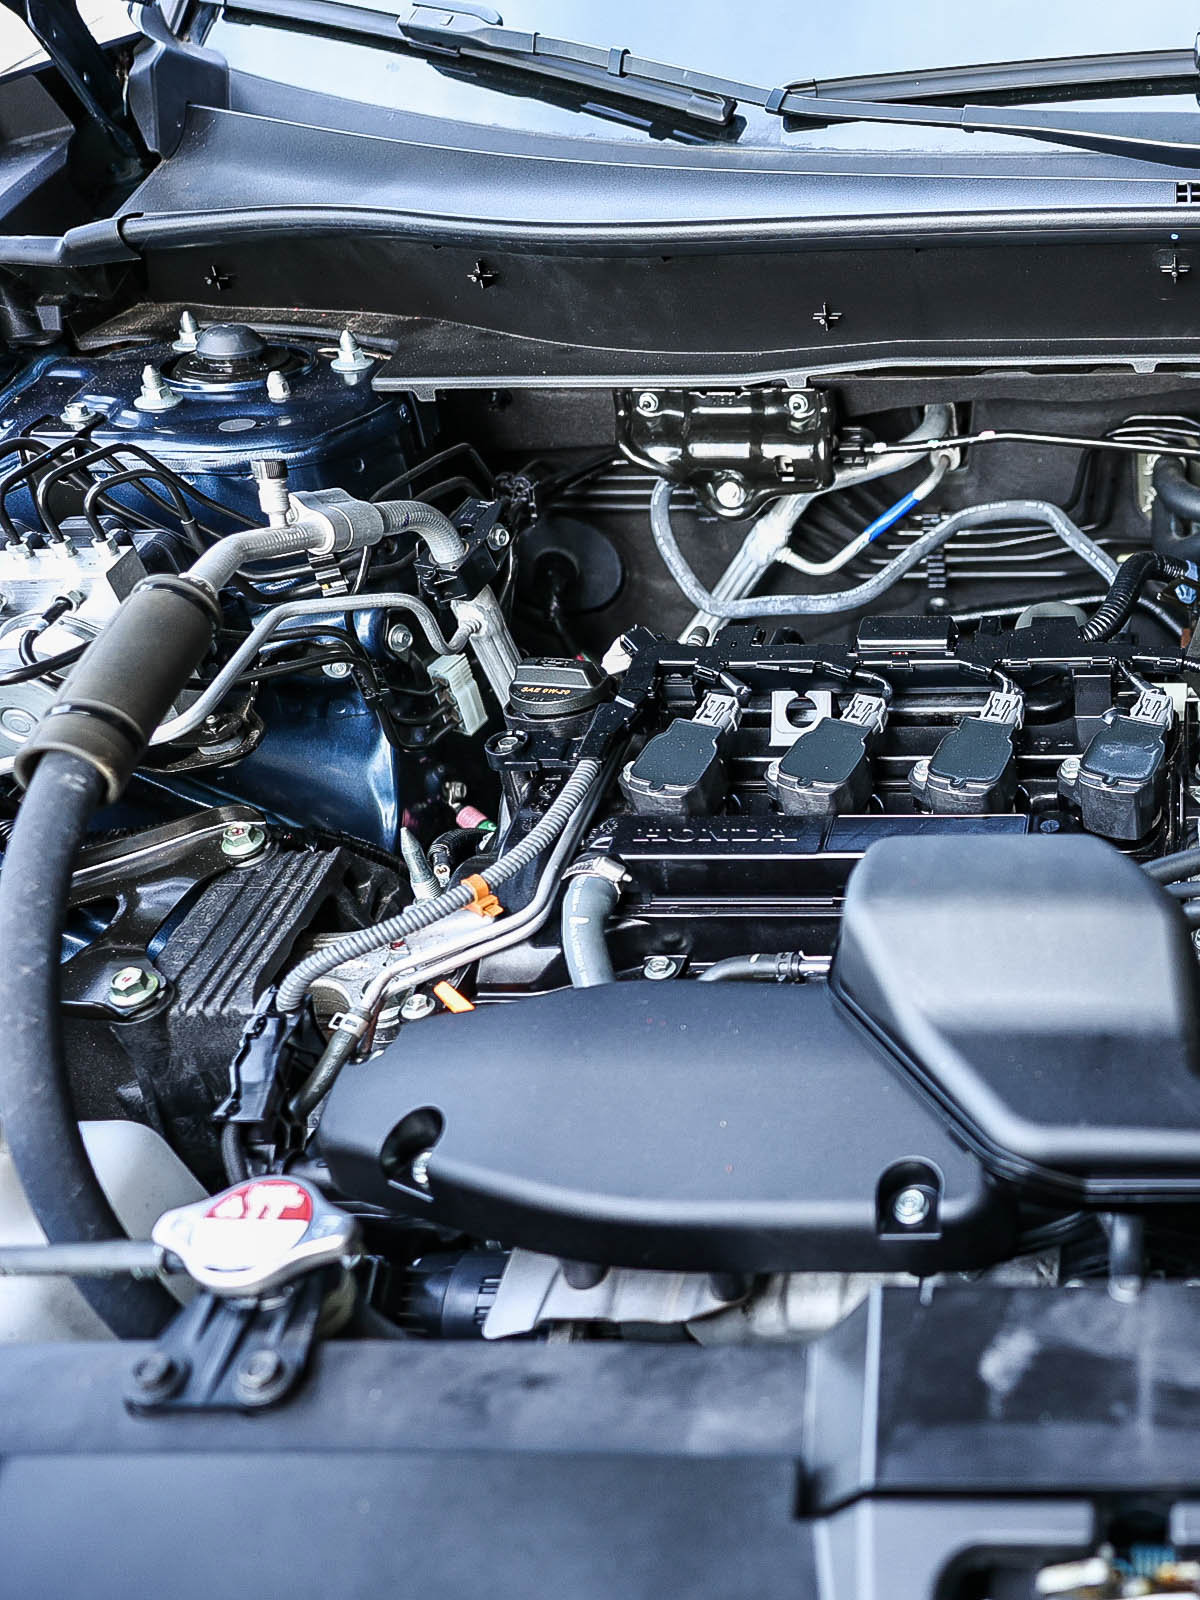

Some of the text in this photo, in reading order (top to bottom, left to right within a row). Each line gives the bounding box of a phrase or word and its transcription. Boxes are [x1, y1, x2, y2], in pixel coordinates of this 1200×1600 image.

[520, 686, 571, 695] SAE 0W-20
[632, 828, 799, 842] HONDA
